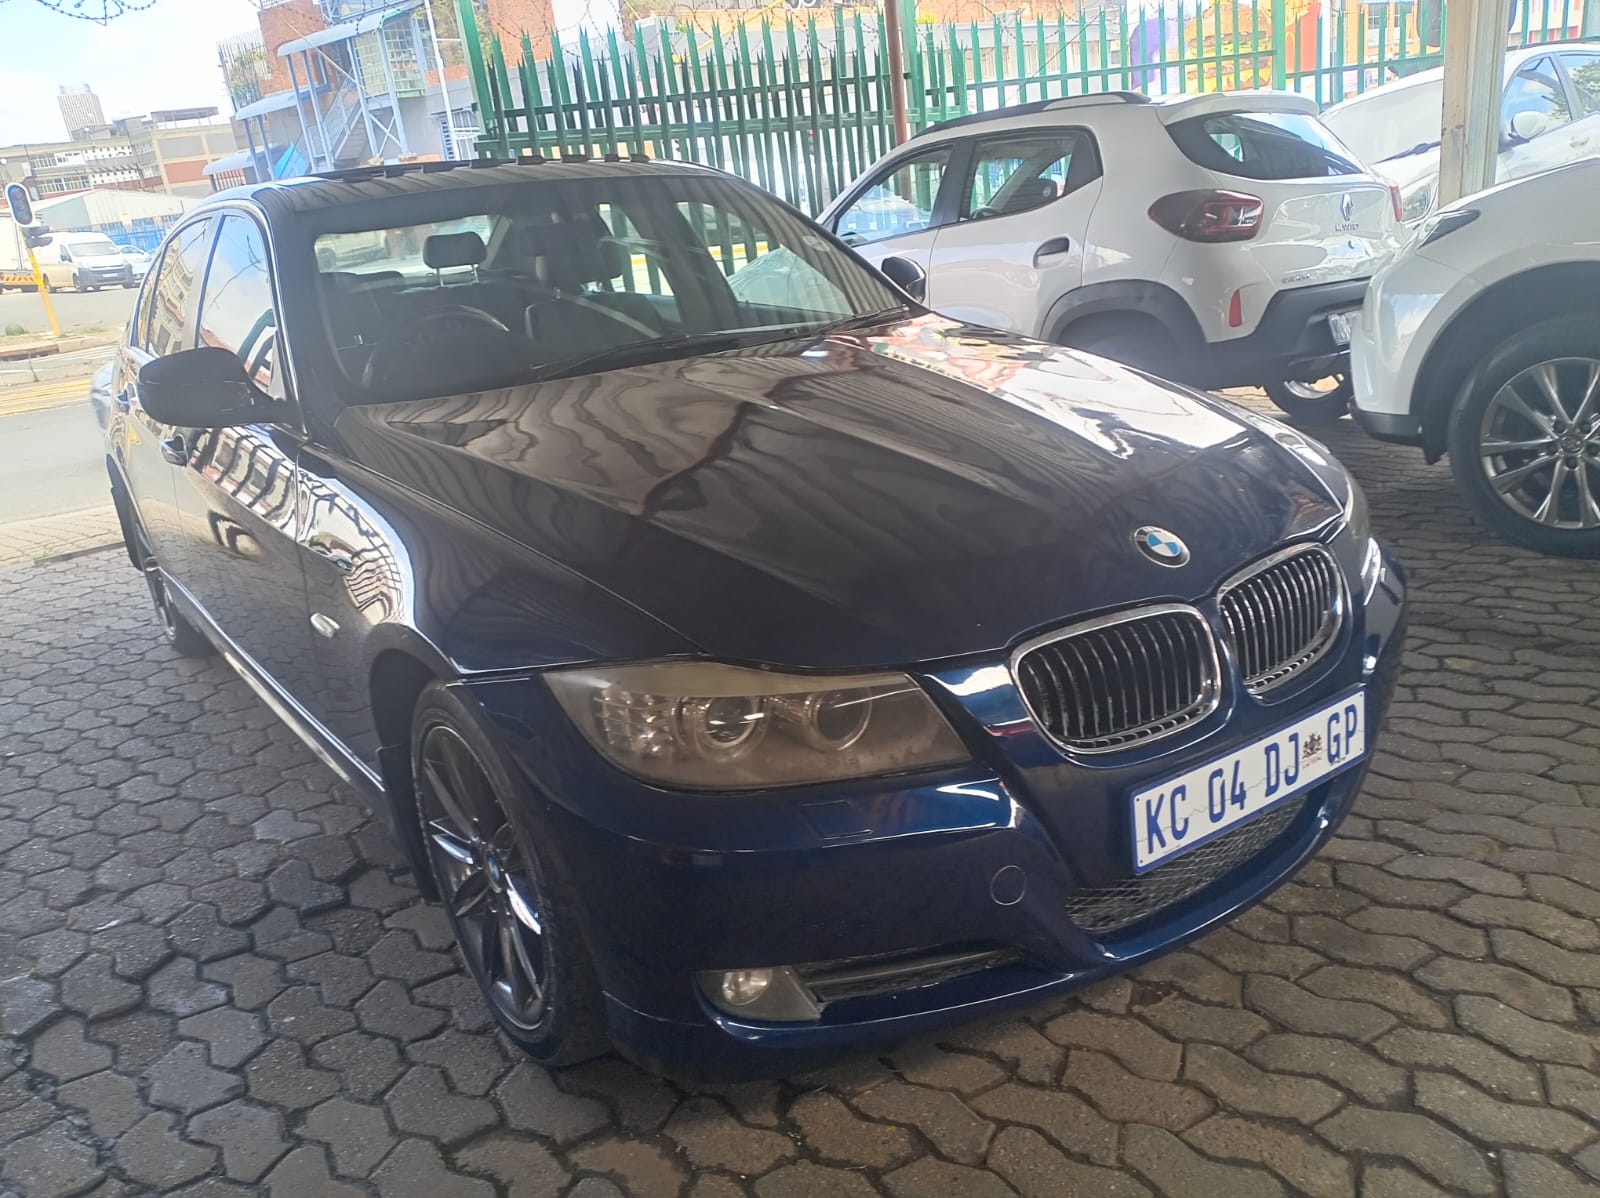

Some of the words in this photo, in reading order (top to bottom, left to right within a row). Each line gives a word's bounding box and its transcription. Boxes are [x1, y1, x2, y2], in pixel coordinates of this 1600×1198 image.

[1145, 783, 1190, 855] KC
[1208, 759, 1247, 824] 04
[1264, 731, 1299, 798] DJ
[1327, 703, 1358, 764] GP
